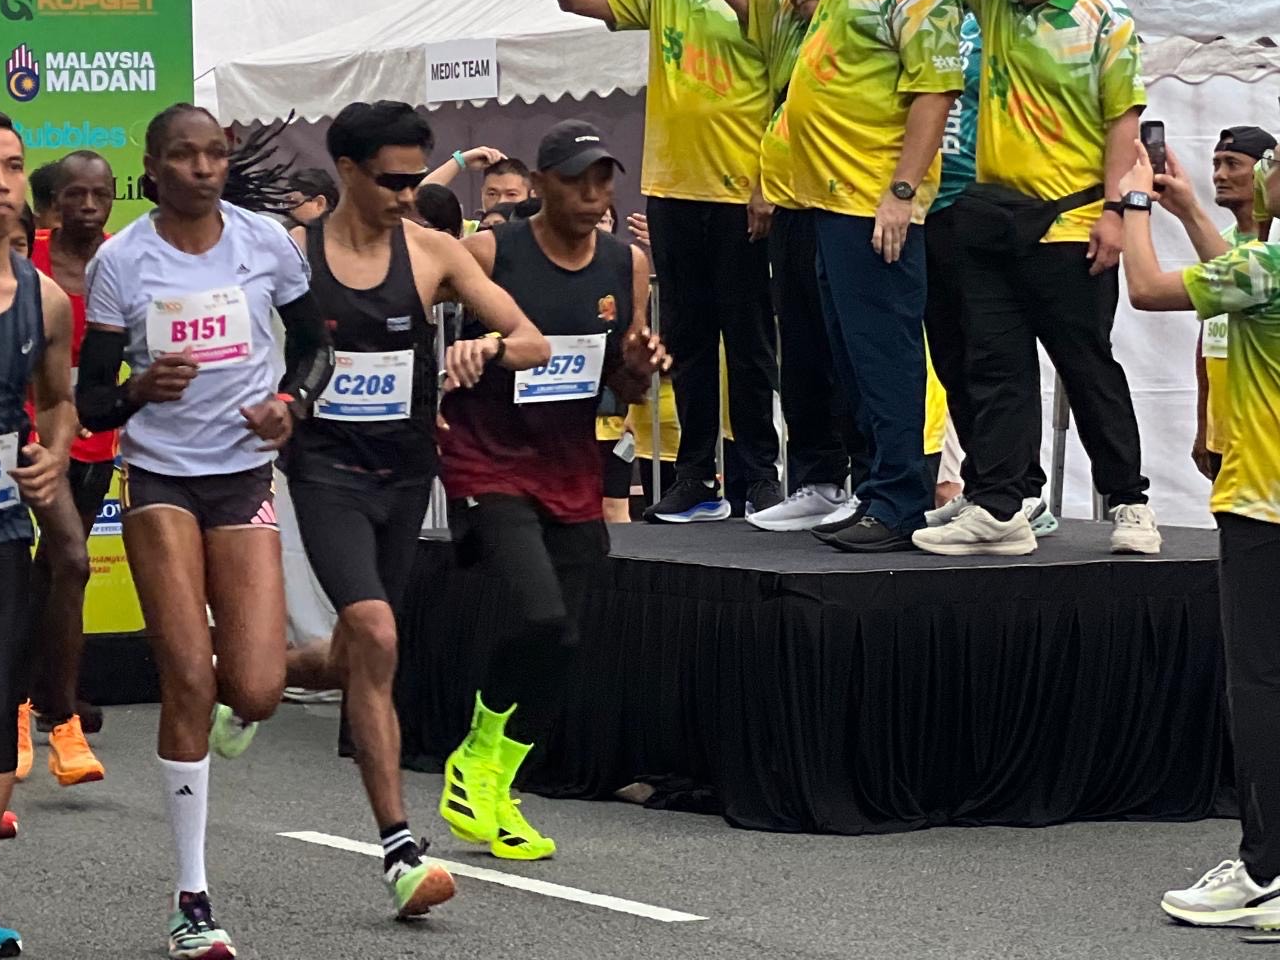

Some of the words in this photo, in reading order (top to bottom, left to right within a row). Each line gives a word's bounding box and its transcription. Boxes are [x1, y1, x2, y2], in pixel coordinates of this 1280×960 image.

[45, 51, 155, 69] MALAYSIA
[431, 61, 461, 81] MEDIC
[462, 59, 490, 78] TEAM
[46, 69, 156, 92] MADANI
[12, 120, 127, 149] ubbles
[171, 314, 226, 343] B151
[334, 374, 396, 396] C208
